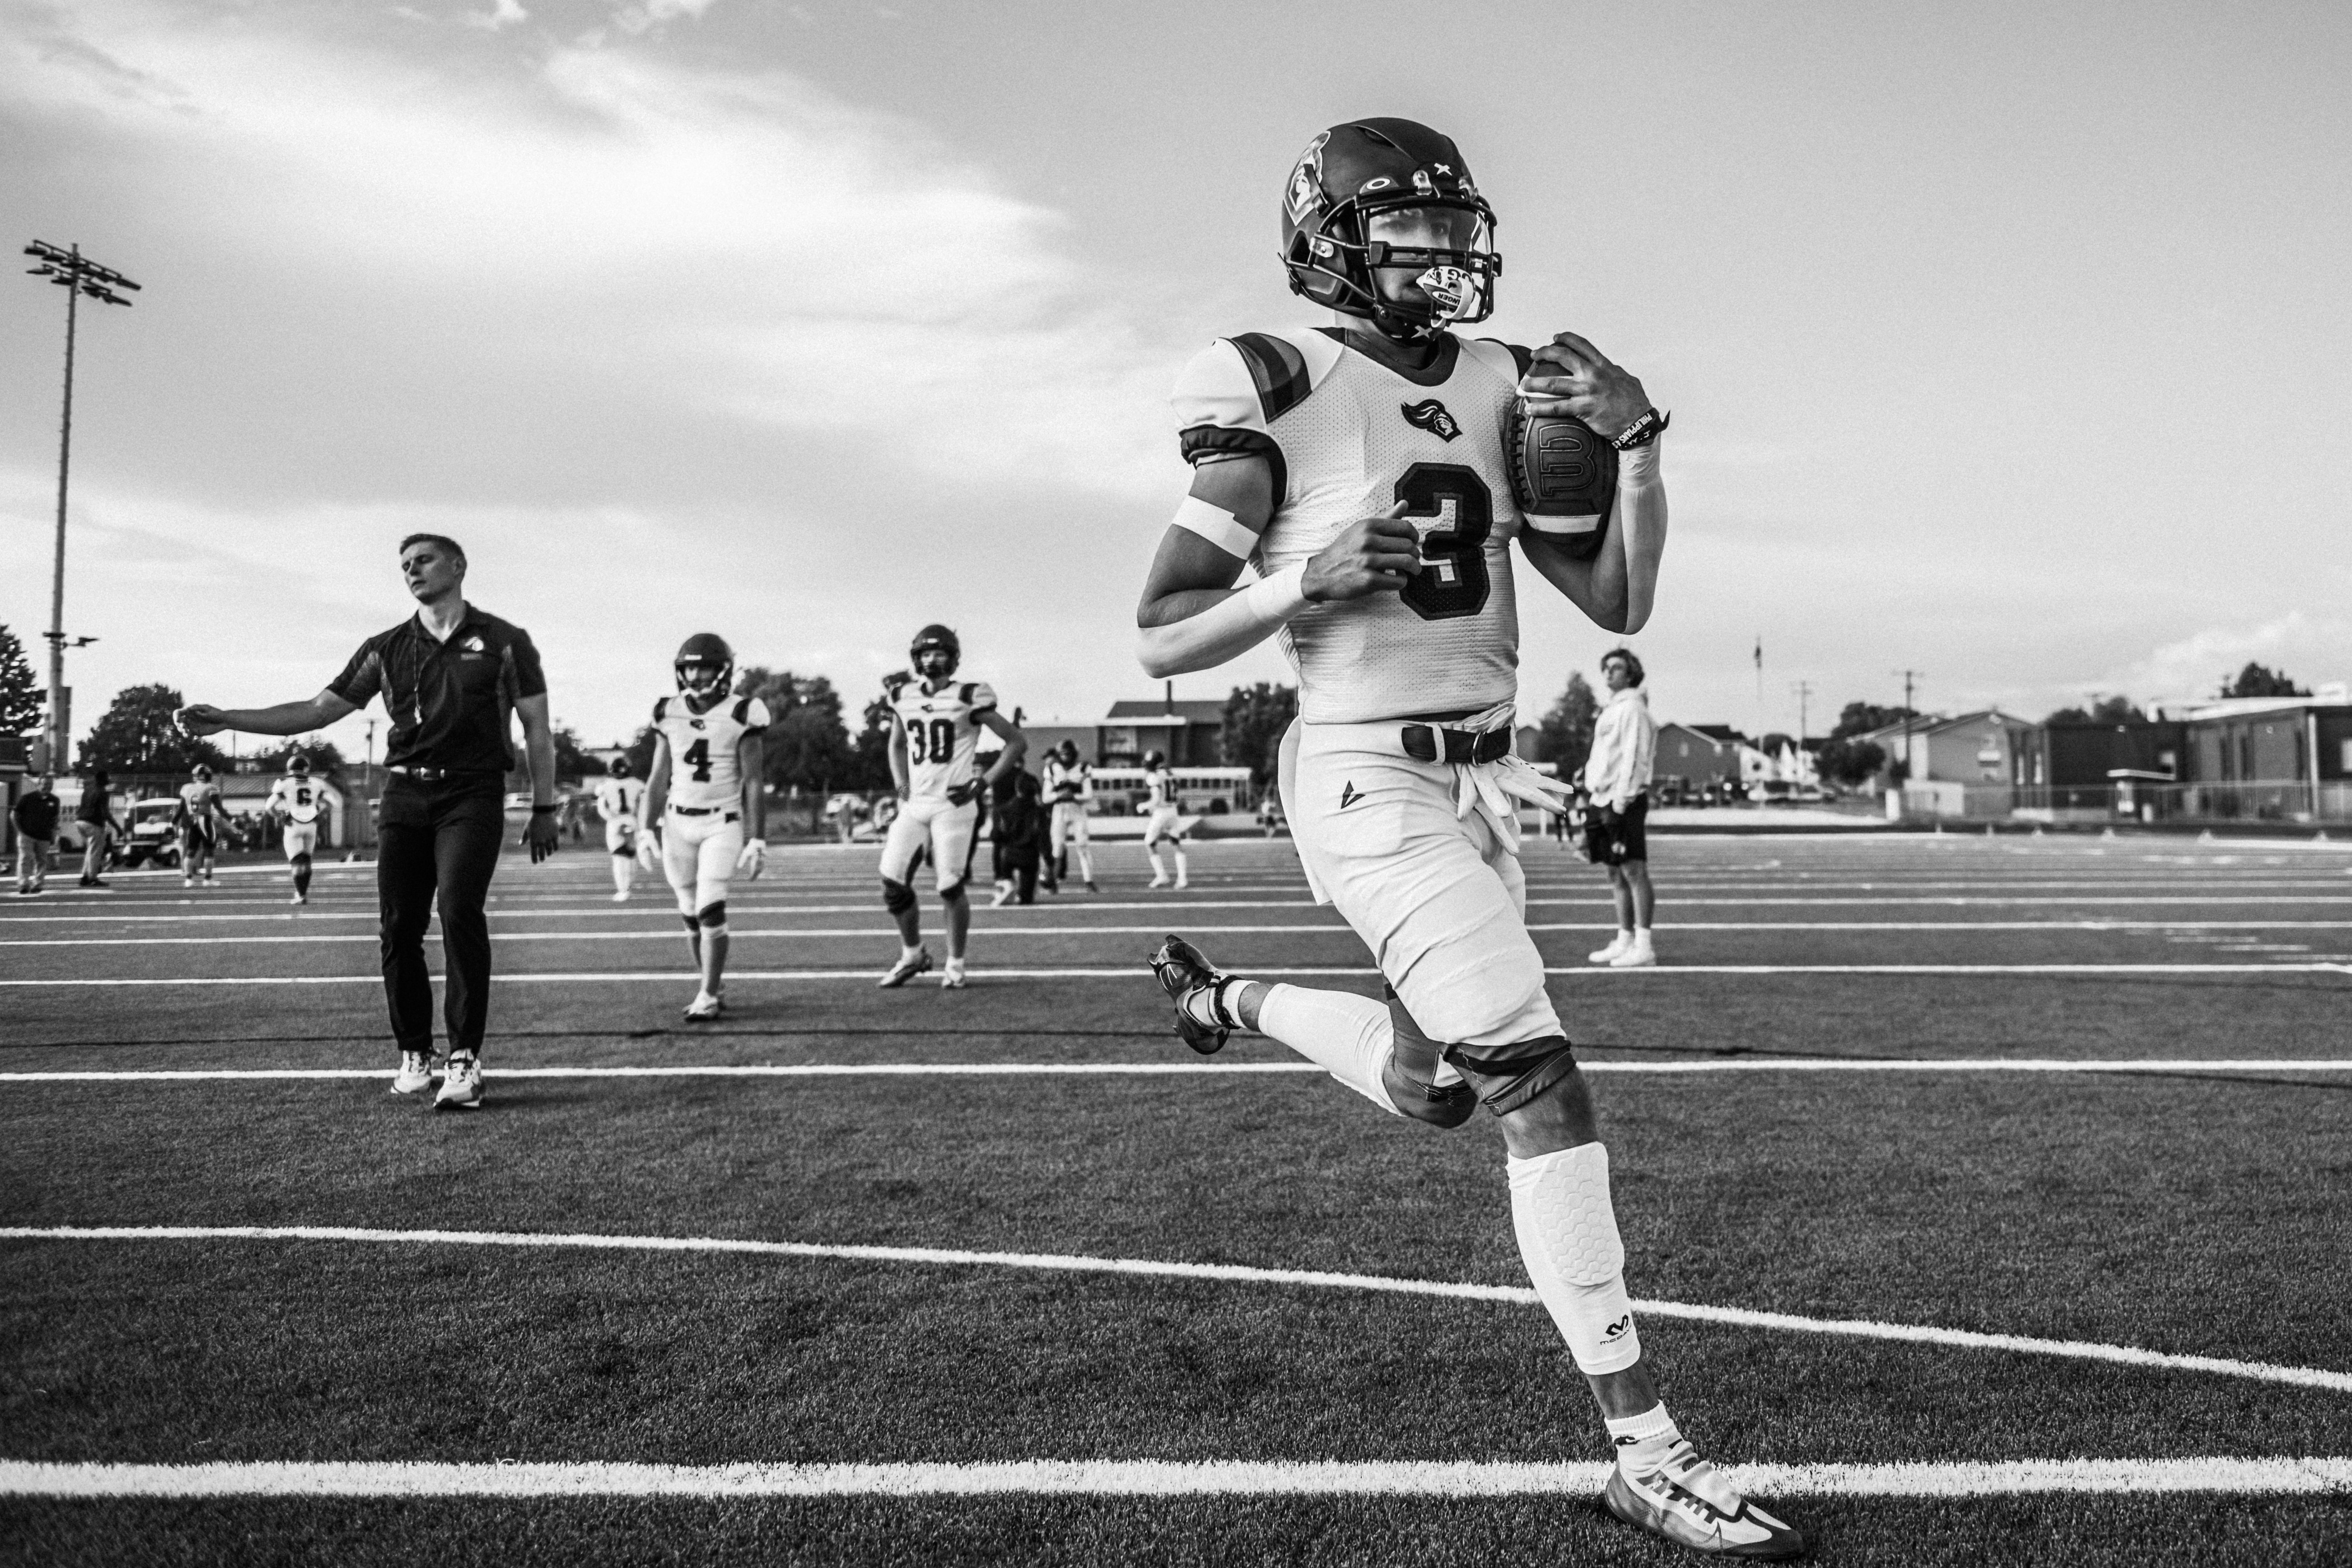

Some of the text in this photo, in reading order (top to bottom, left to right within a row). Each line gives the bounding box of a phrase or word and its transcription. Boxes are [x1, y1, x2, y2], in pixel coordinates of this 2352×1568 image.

[1618, 413, 1653, 443] PHILIPPIANS
[1394, 462, 1494, 621] 3
[684, 739, 714, 782] 4
[907, 719, 955, 765] 30
[618, 788, 631, 815] 1
